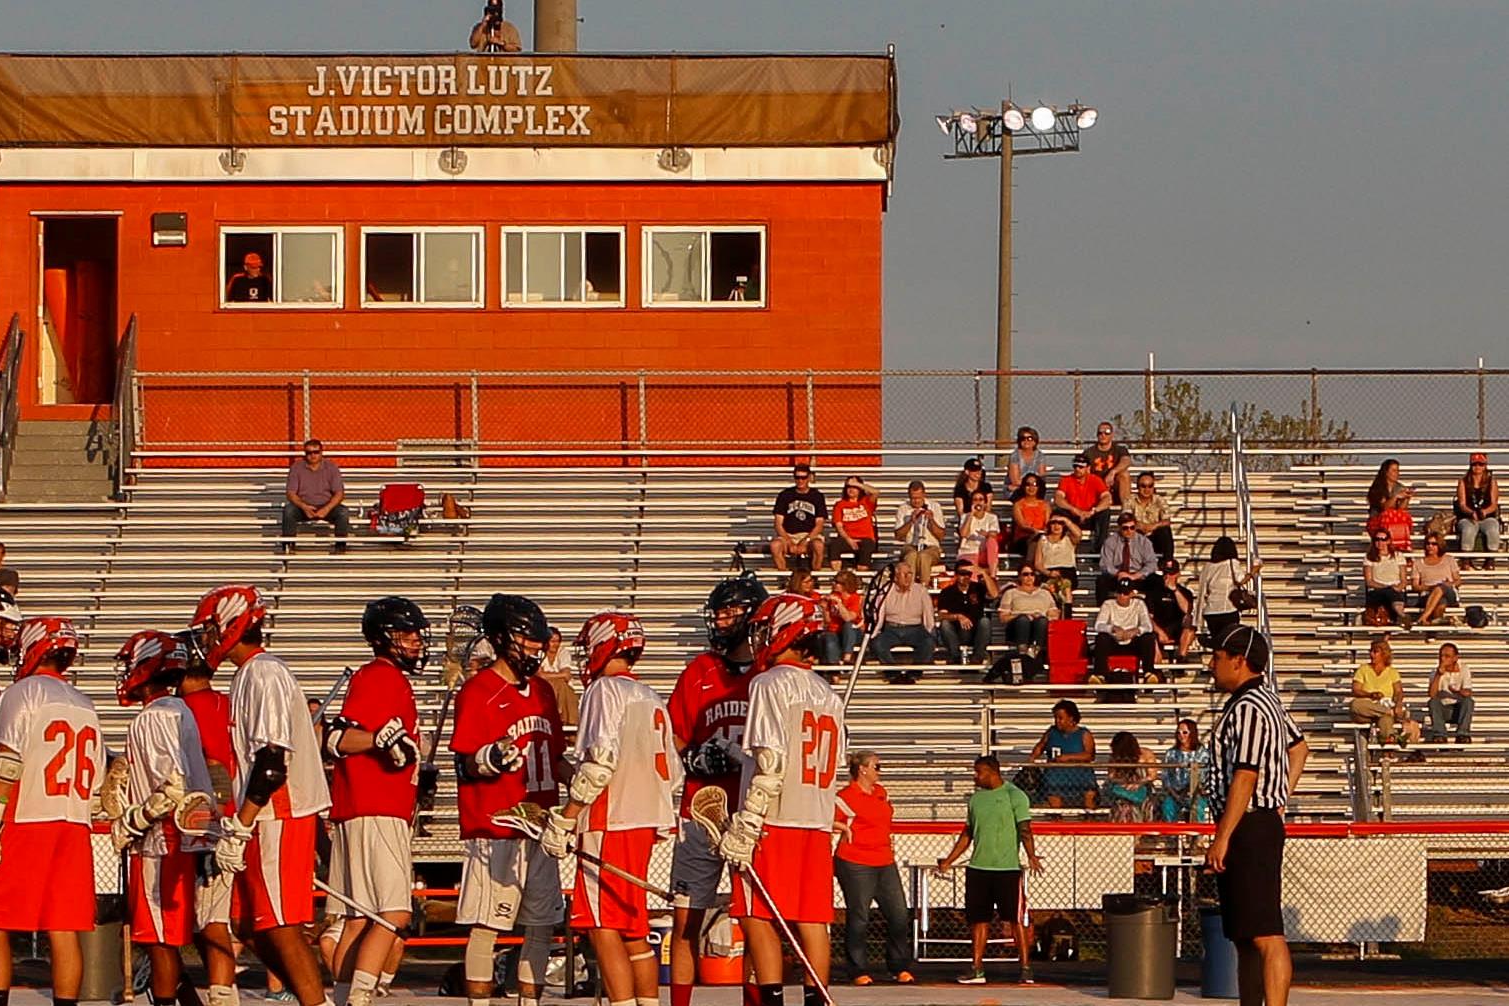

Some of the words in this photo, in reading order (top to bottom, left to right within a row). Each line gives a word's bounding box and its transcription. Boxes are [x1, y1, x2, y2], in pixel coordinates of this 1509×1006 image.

[467, 65, 553, 96] LUTZ
[269, 105, 426, 136] STADIUM
[435, 104, 591, 136] COMPLEX
[44, 720, 98, 800] 26
[522, 740, 555, 792] 11
[801, 710, 839, 789] 20
